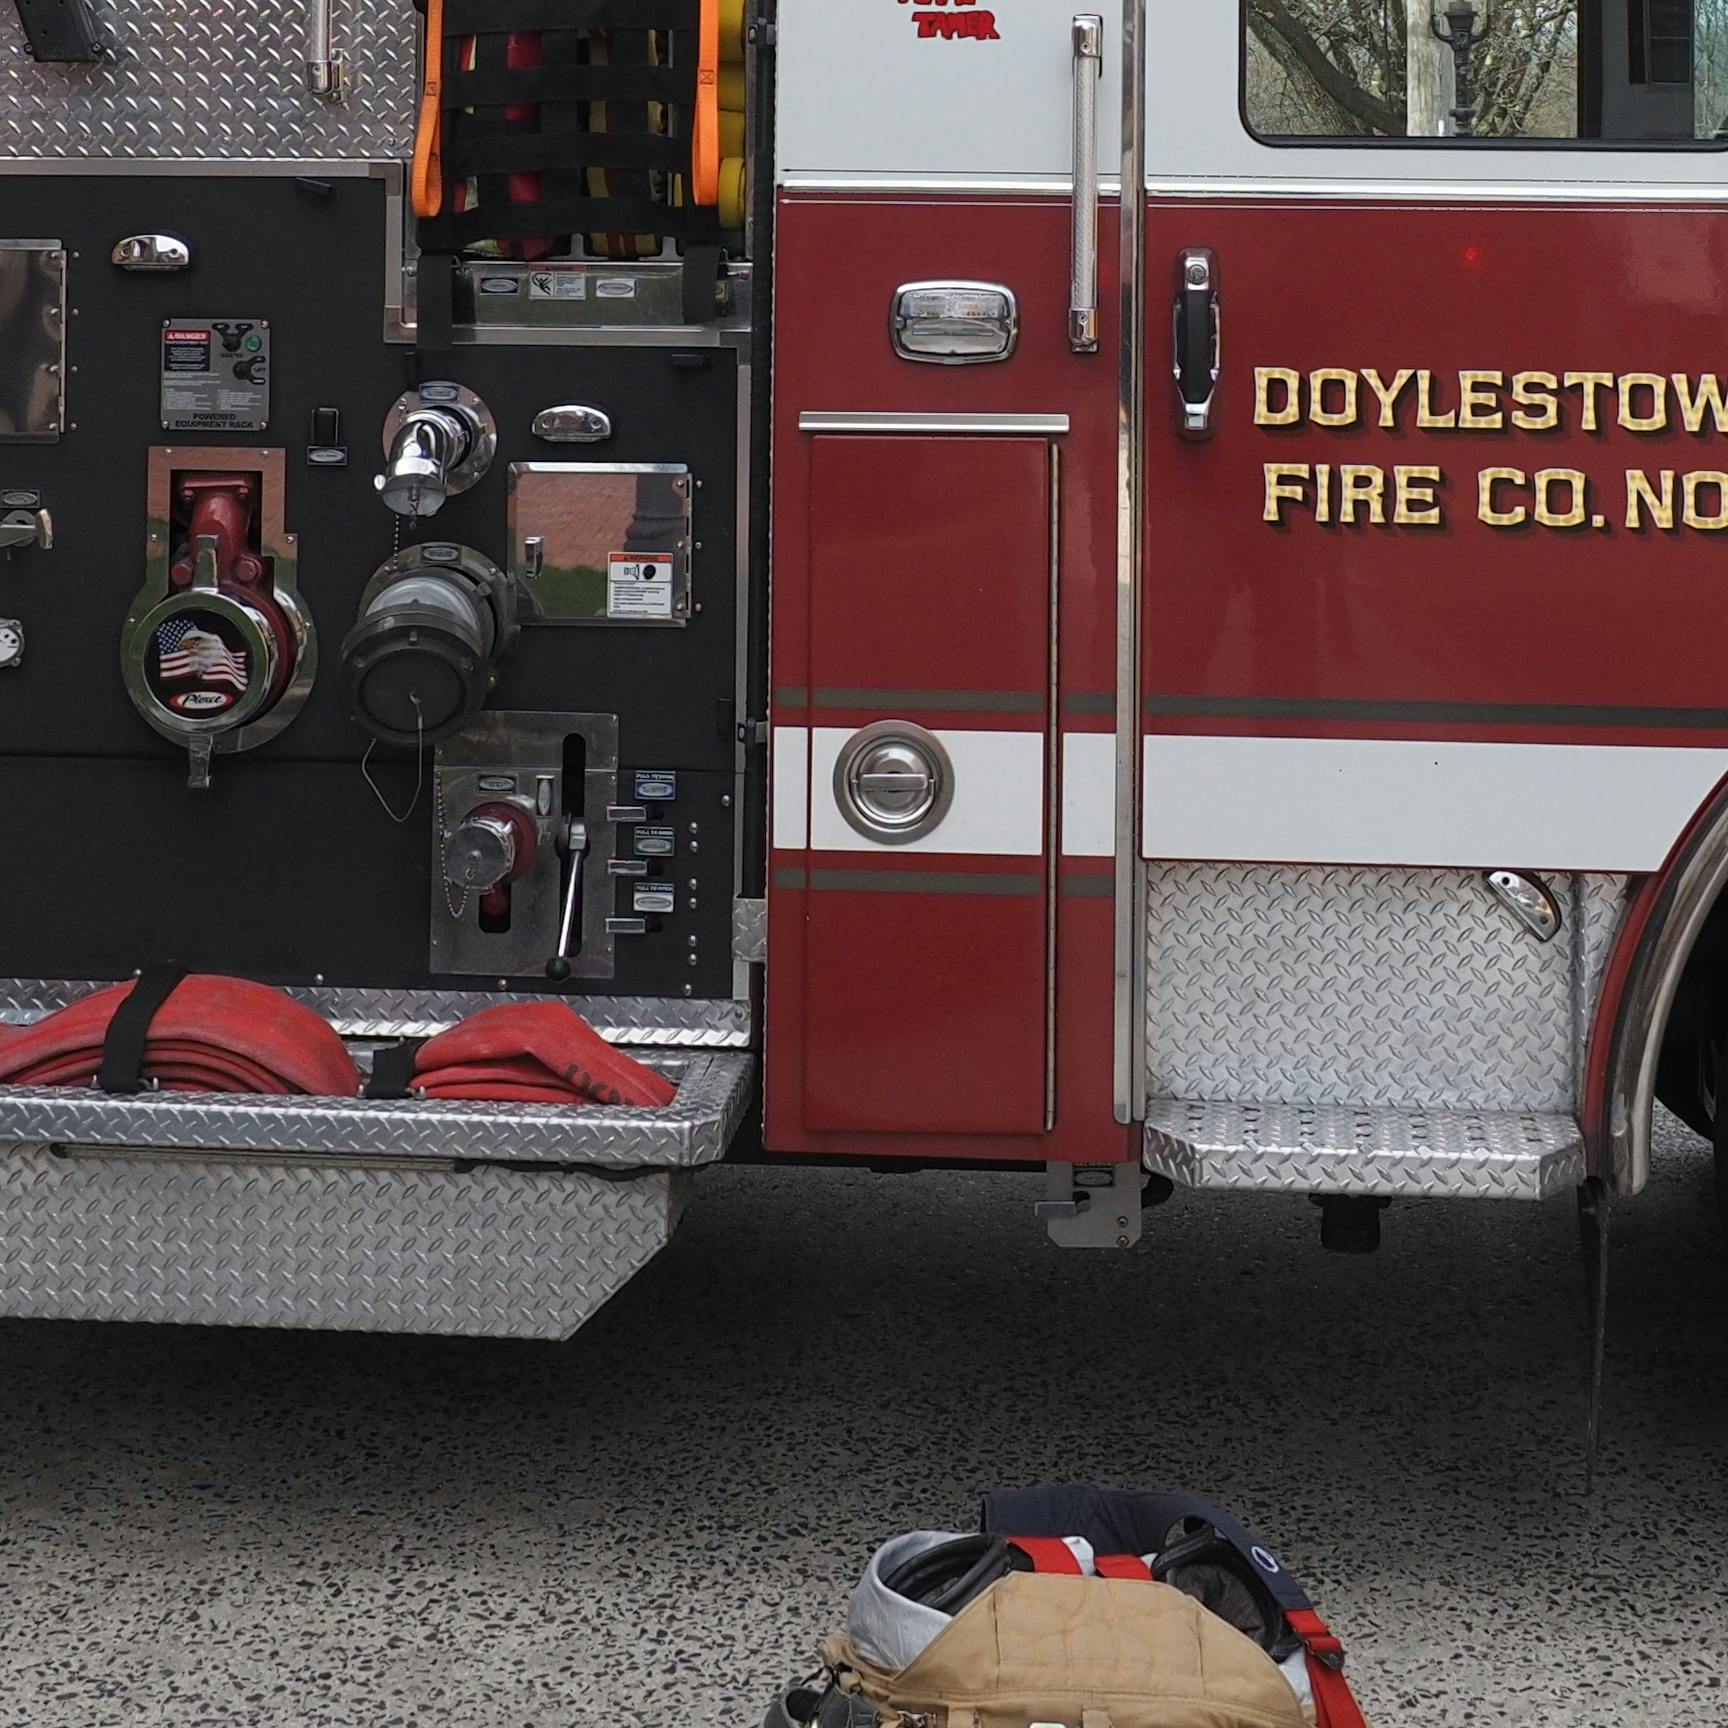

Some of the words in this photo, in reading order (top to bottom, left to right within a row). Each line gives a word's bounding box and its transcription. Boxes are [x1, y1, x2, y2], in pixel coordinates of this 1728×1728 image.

[911, 10, 1000, 40] TAMER
[1263, 463, 1440, 524] FIRE
[1478, 466, 1604, 527] CO.
[183, 694, 222, 707] Pierce
